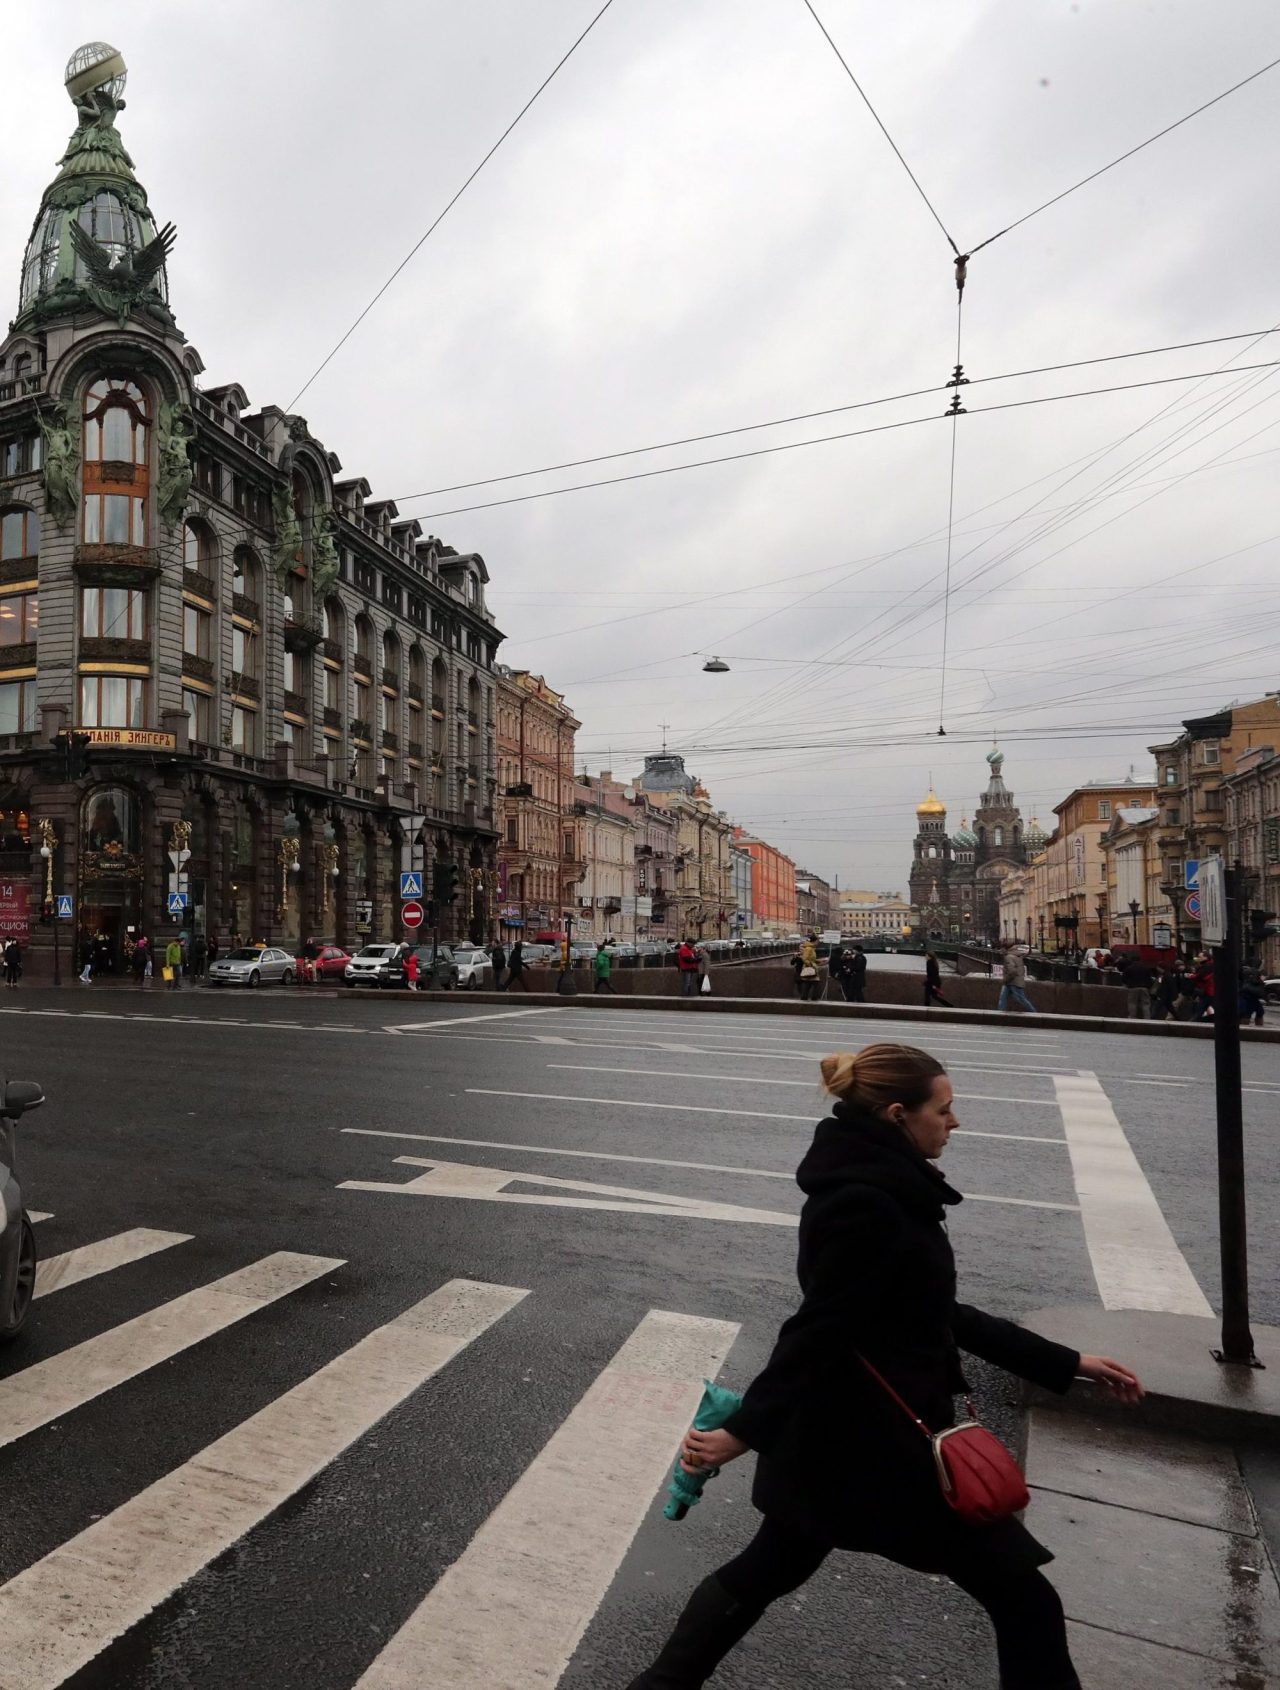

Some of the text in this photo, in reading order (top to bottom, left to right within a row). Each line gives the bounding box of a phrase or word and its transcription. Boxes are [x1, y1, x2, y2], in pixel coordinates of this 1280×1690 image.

[66, 730, 171, 746] МПАНІЯ ЗИНГЕРЪ
[2, 886, 13, 897] 14
